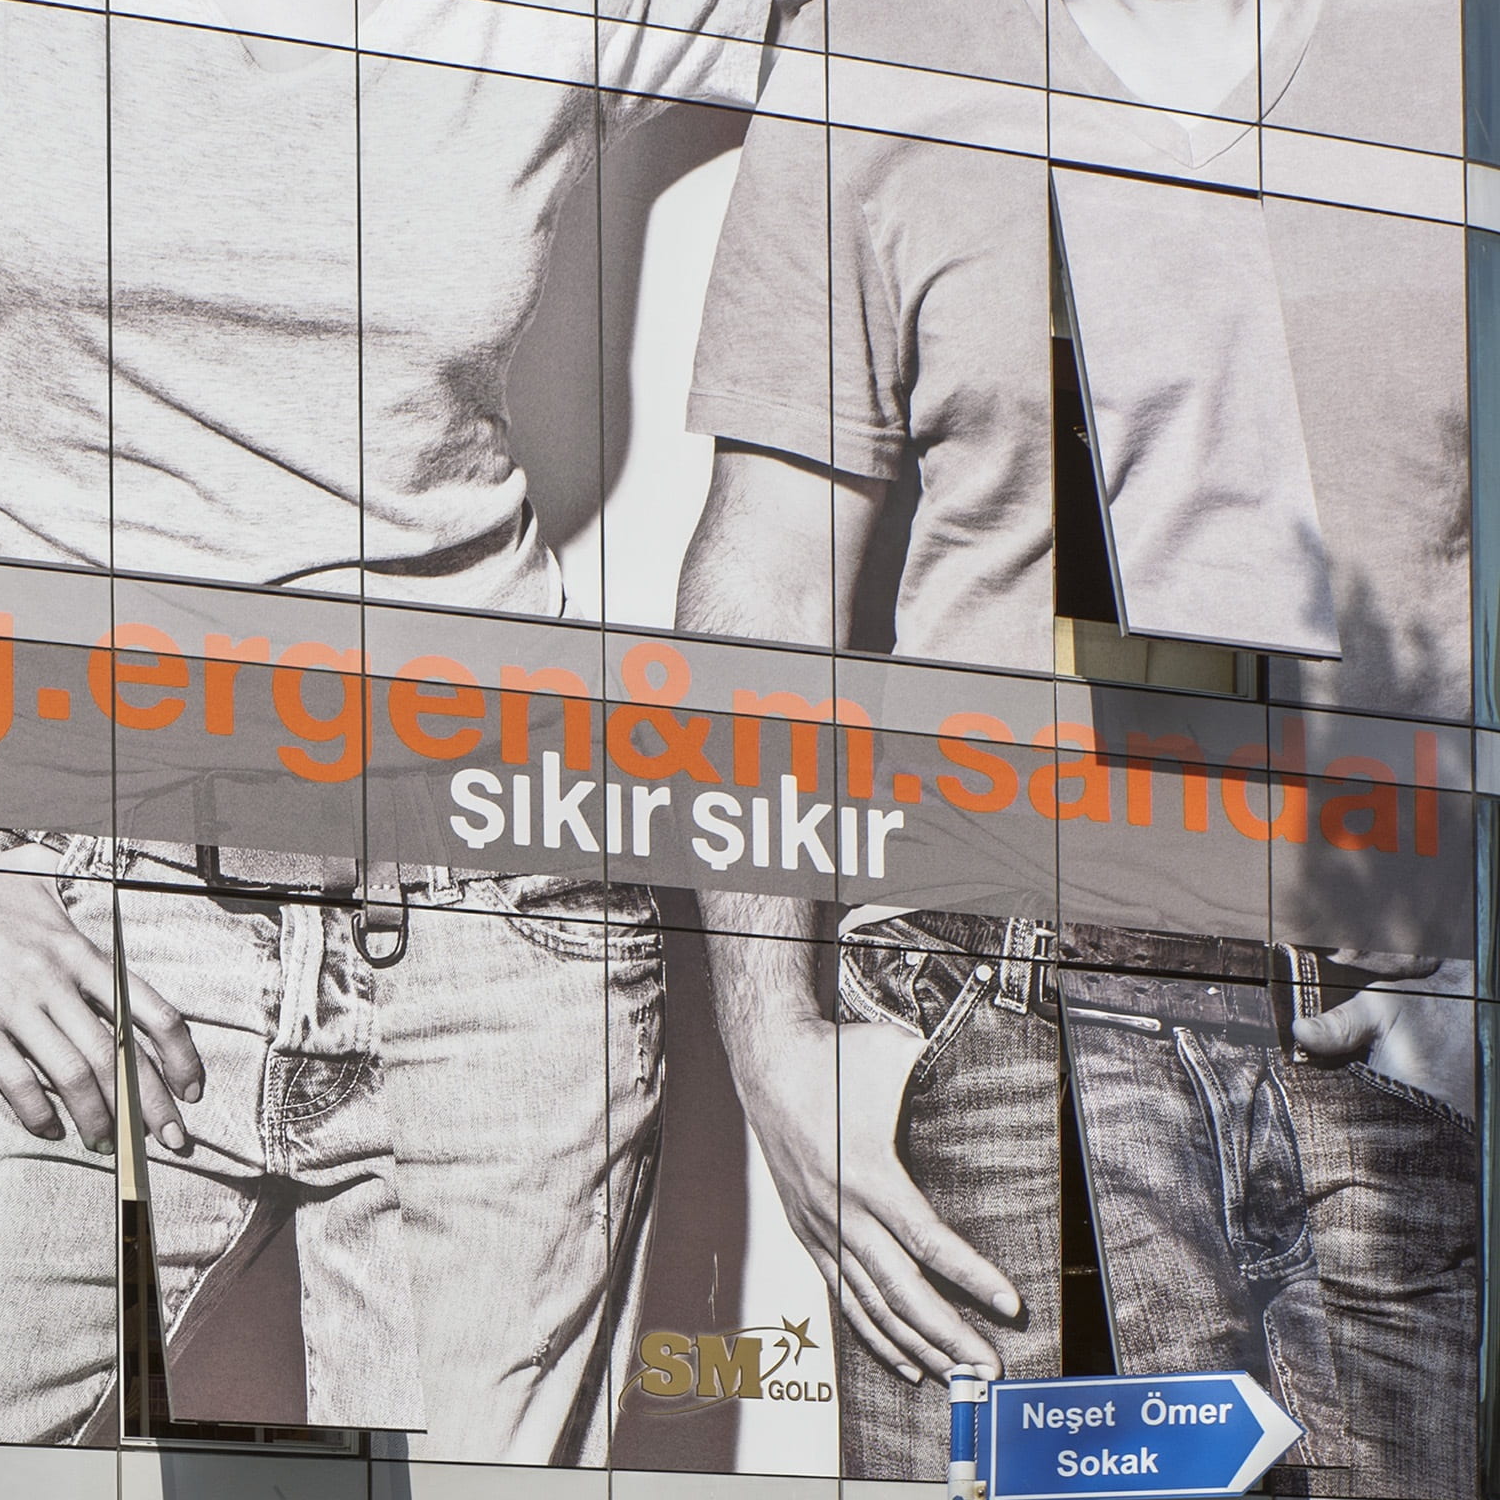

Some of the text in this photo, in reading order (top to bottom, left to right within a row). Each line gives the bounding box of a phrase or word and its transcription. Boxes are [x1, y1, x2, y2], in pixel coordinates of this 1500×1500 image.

[640, 1331, 832, 1402] SM GOLD
[1022, 1391, 1233, 1434] Neşet Ömer
[1056, 1446, 1159, 1478] Sokak
